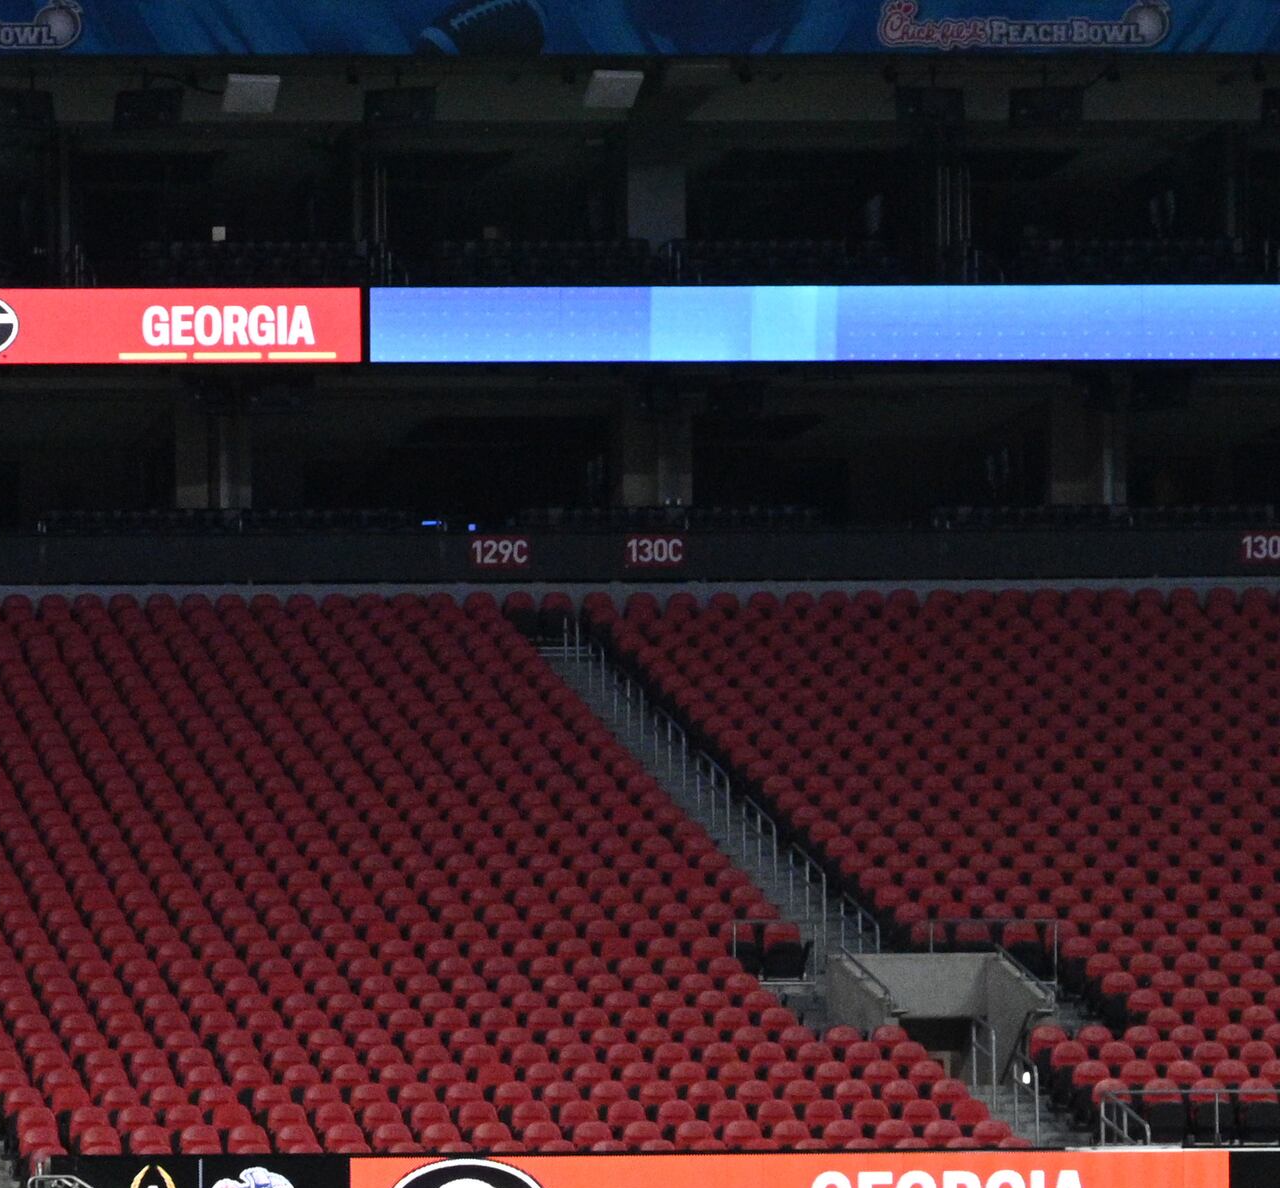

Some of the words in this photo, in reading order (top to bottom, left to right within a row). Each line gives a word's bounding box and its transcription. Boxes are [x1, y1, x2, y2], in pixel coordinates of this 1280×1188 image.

[989, 19, 1070, 44] PEACH
[1071, 18, 1144, 44] BOWL
[142, 306, 316, 347] GEORGIA
[471, 539, 528, 564] 129C
[626, 538, 683, 562] 130C
